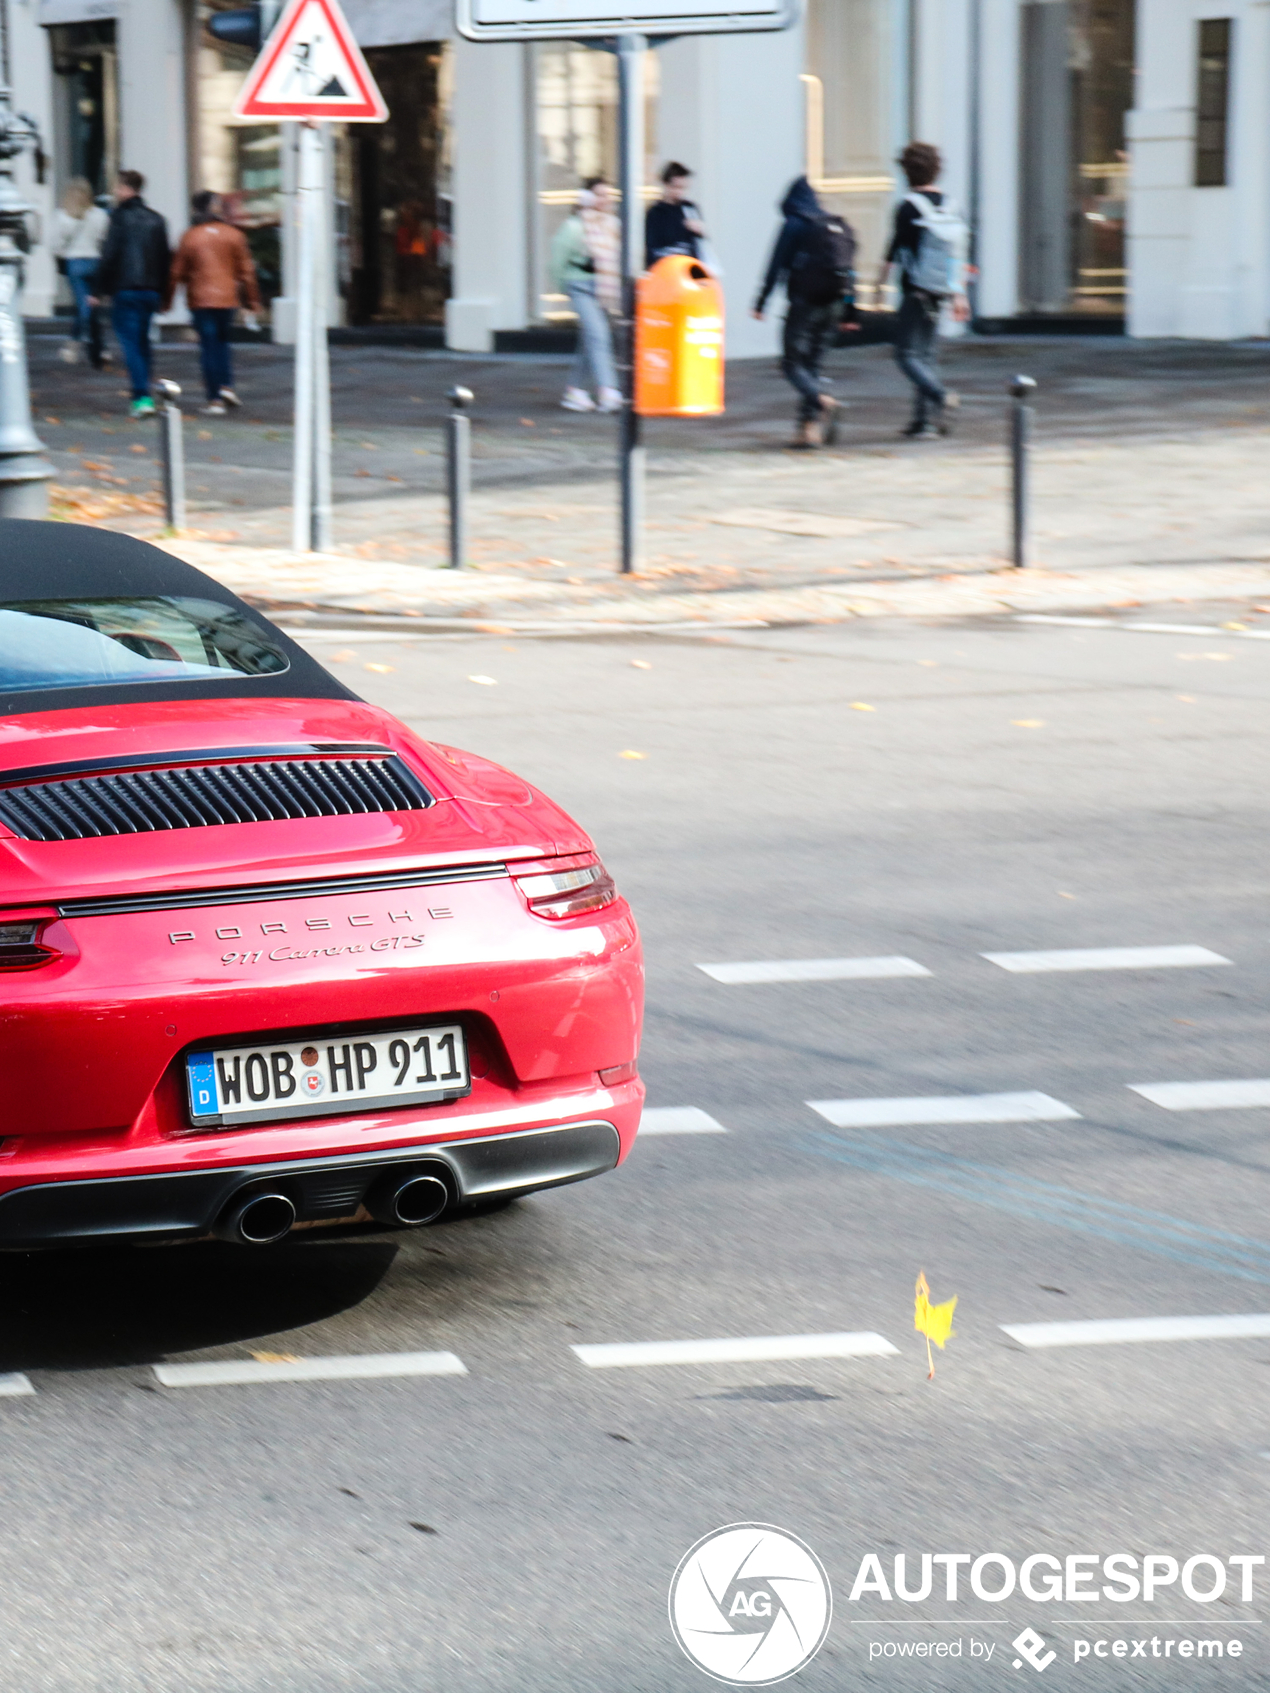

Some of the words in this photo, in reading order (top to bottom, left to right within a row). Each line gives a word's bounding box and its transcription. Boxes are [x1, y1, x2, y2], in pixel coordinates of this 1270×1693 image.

[168, 907, 454, 944] PORSCHE
[221, 949, 263, 966] 911
[269, 943, 365, 962] Carrera
[370, 933, 426, 952] GTS
[217, 1050, 297, 1105] WOB
[327, 1042, 378, 1093] HP
[388, 1033, 462, 1086] 911
[199, 1090, 209, 1105] D
